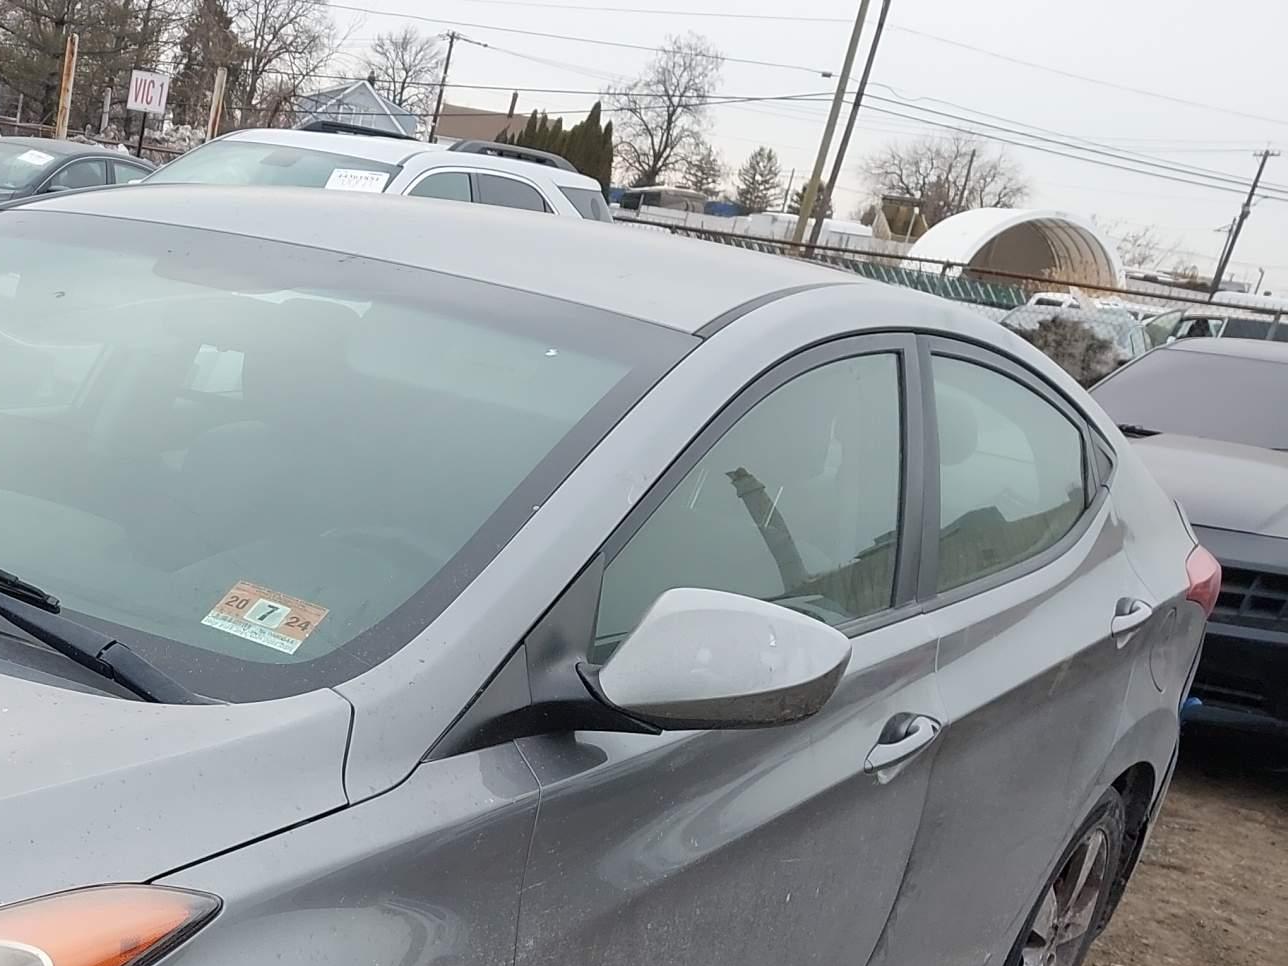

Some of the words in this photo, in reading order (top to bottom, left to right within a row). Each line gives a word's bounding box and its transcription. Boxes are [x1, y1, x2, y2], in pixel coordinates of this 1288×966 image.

[134, 77, 155, 105] VIC
[158, 82, 165, 107] 1
[225, 595, 249, 610] 20
[257, 604, 280, 622] 7
[284, 616, 312, 632] 24
